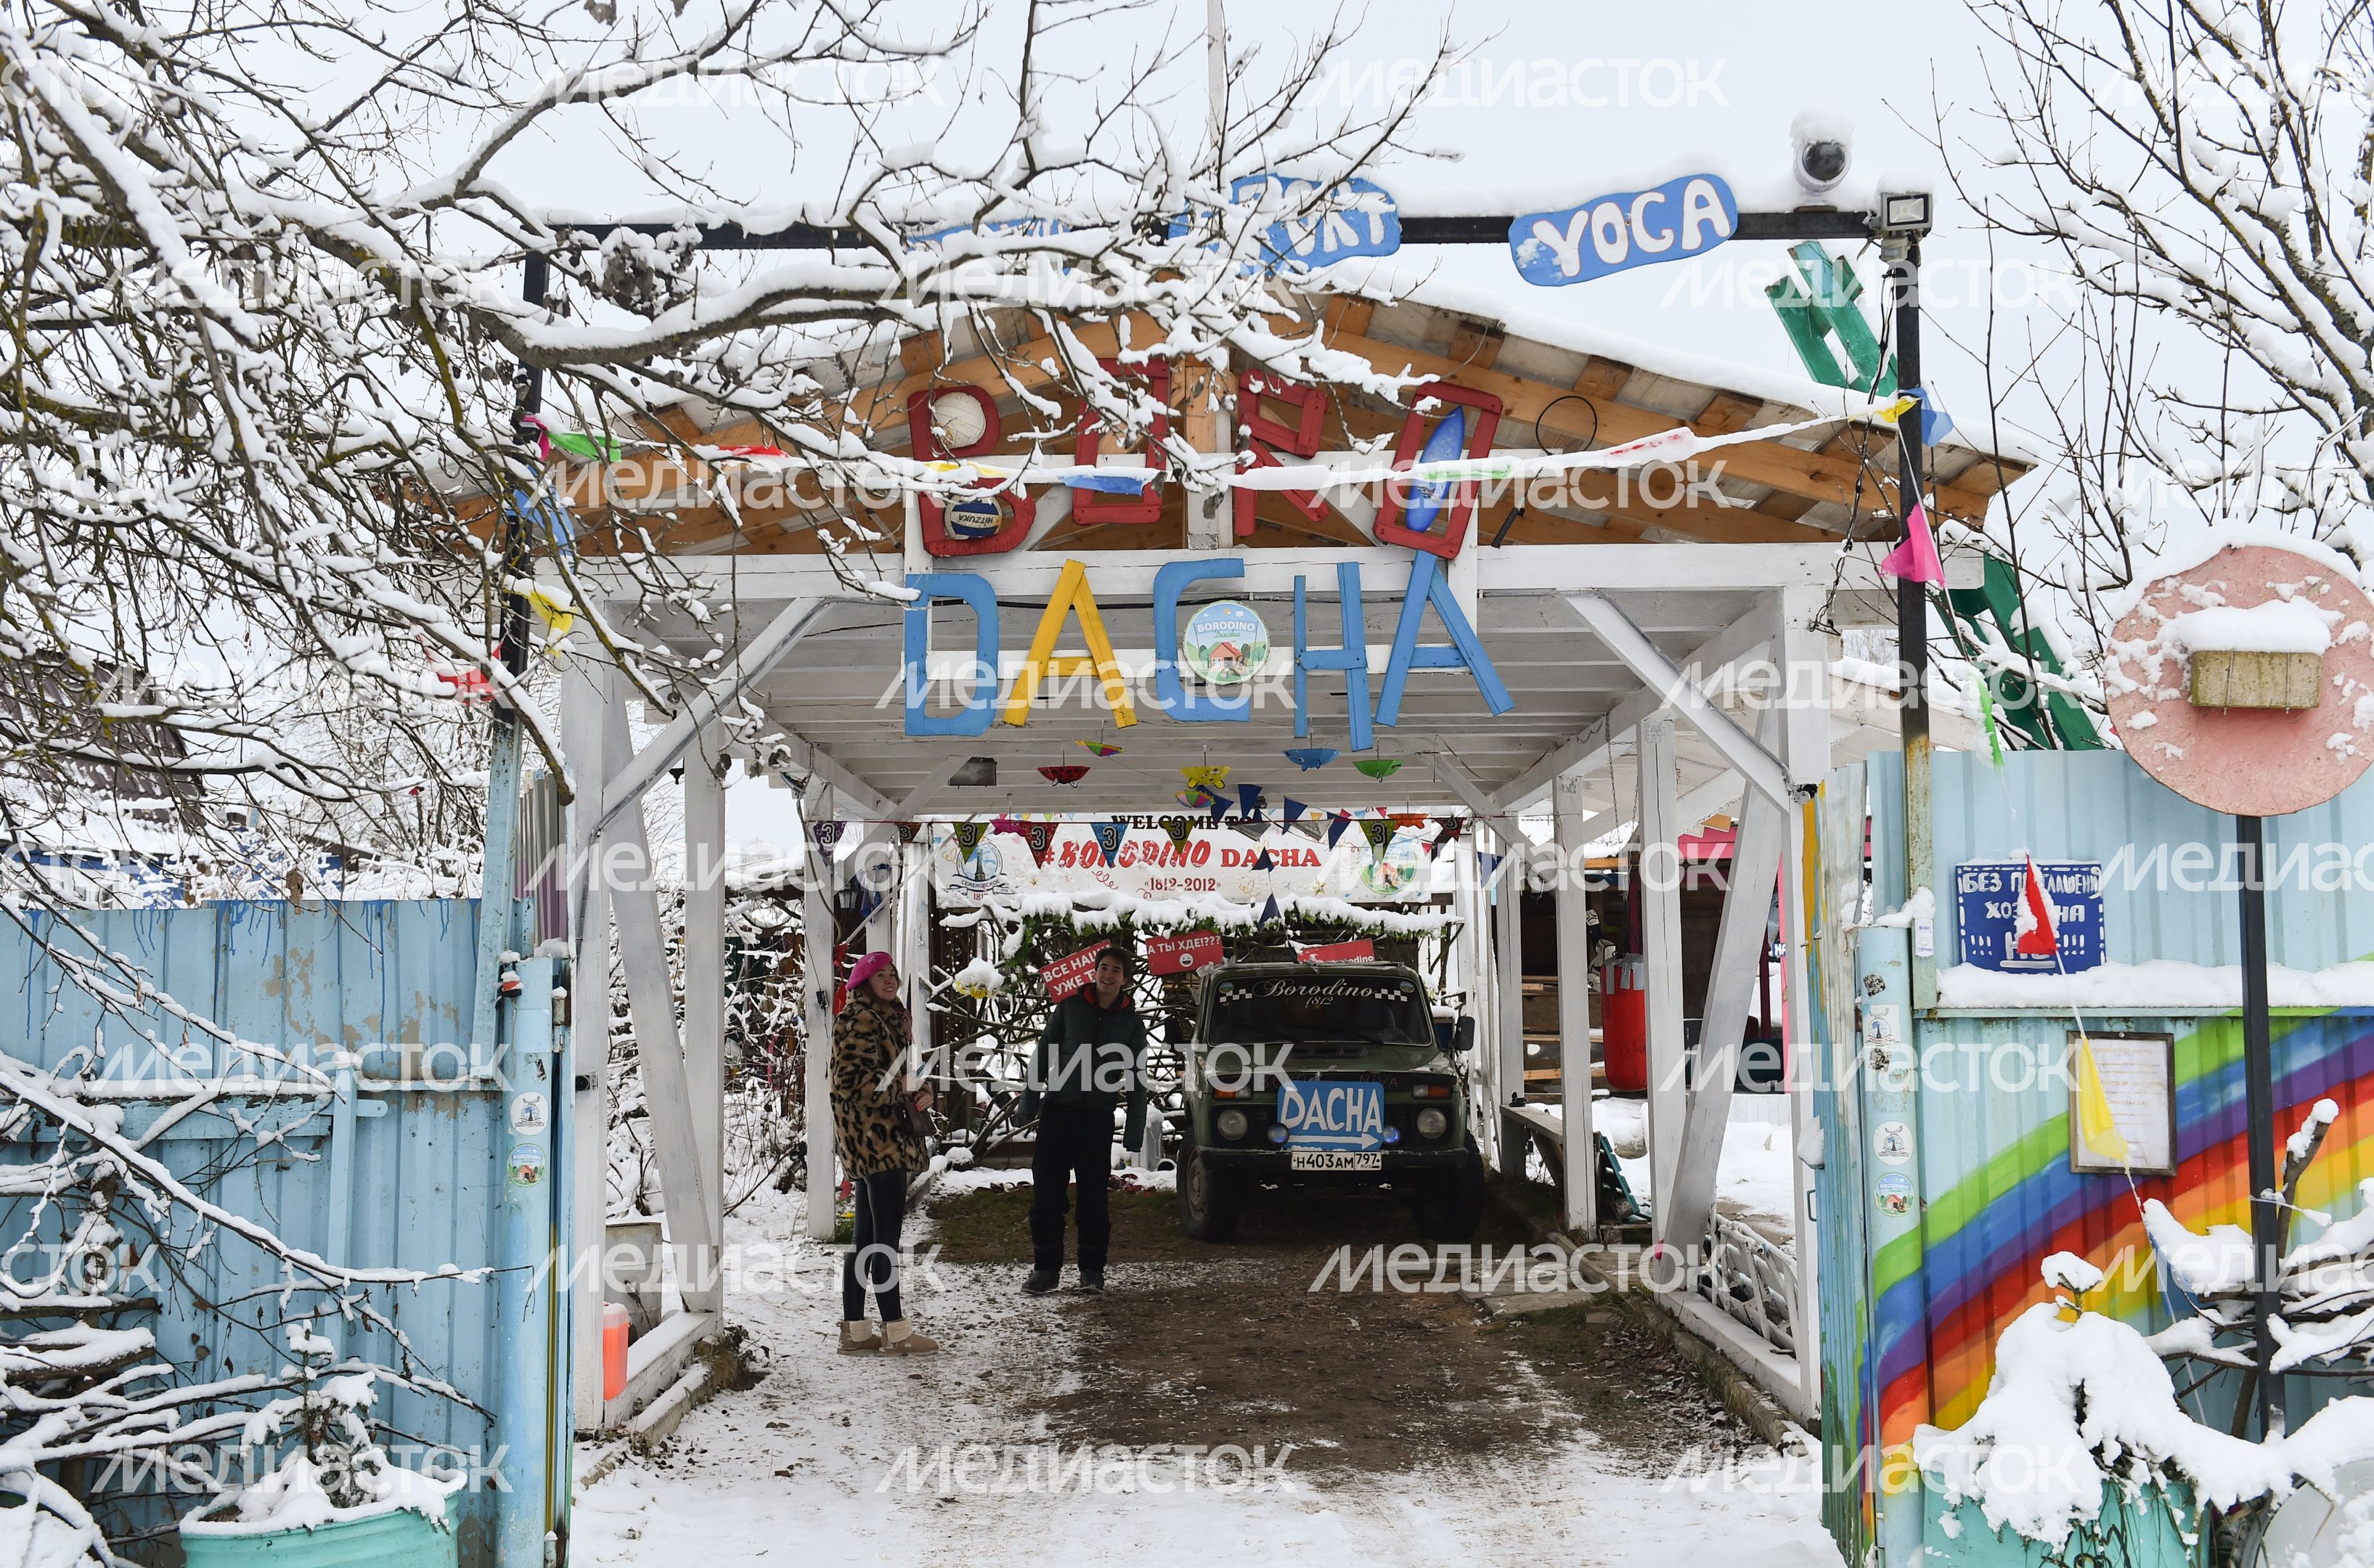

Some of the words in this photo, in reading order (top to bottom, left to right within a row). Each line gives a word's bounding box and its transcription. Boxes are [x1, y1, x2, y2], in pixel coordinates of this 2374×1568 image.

[1196, 621, 1256, 632] BORODINO
[1212, 629, 1241, 639] Dacha
[904, 549, 1515, 752] DACHA
[960, 822, 976, 846] 3
[1030, 826, 1046, 850] 3
[1102, 825, 1119, 850] 3
[1220, 848, 1321, 867] DACHA
[1962, 872, 2002, 893] БЕЗ
[1148, 944, 1156, 955] А
[1157, 942, 1175, 952] ТЫ
[1178, 935, 1221, 952] ХДЕ!???
[1043, 963, 1070, 983] ВСЕ
[1053, 974, 1085, 996] УЖЕ
[1252, 978, 1377, 998] Borodino
[1305, 996, 1334, 1008] 1812
[1280, 1087, 1383, 1133] DACHA
[1355, 1153, 1377, 1164] 797
